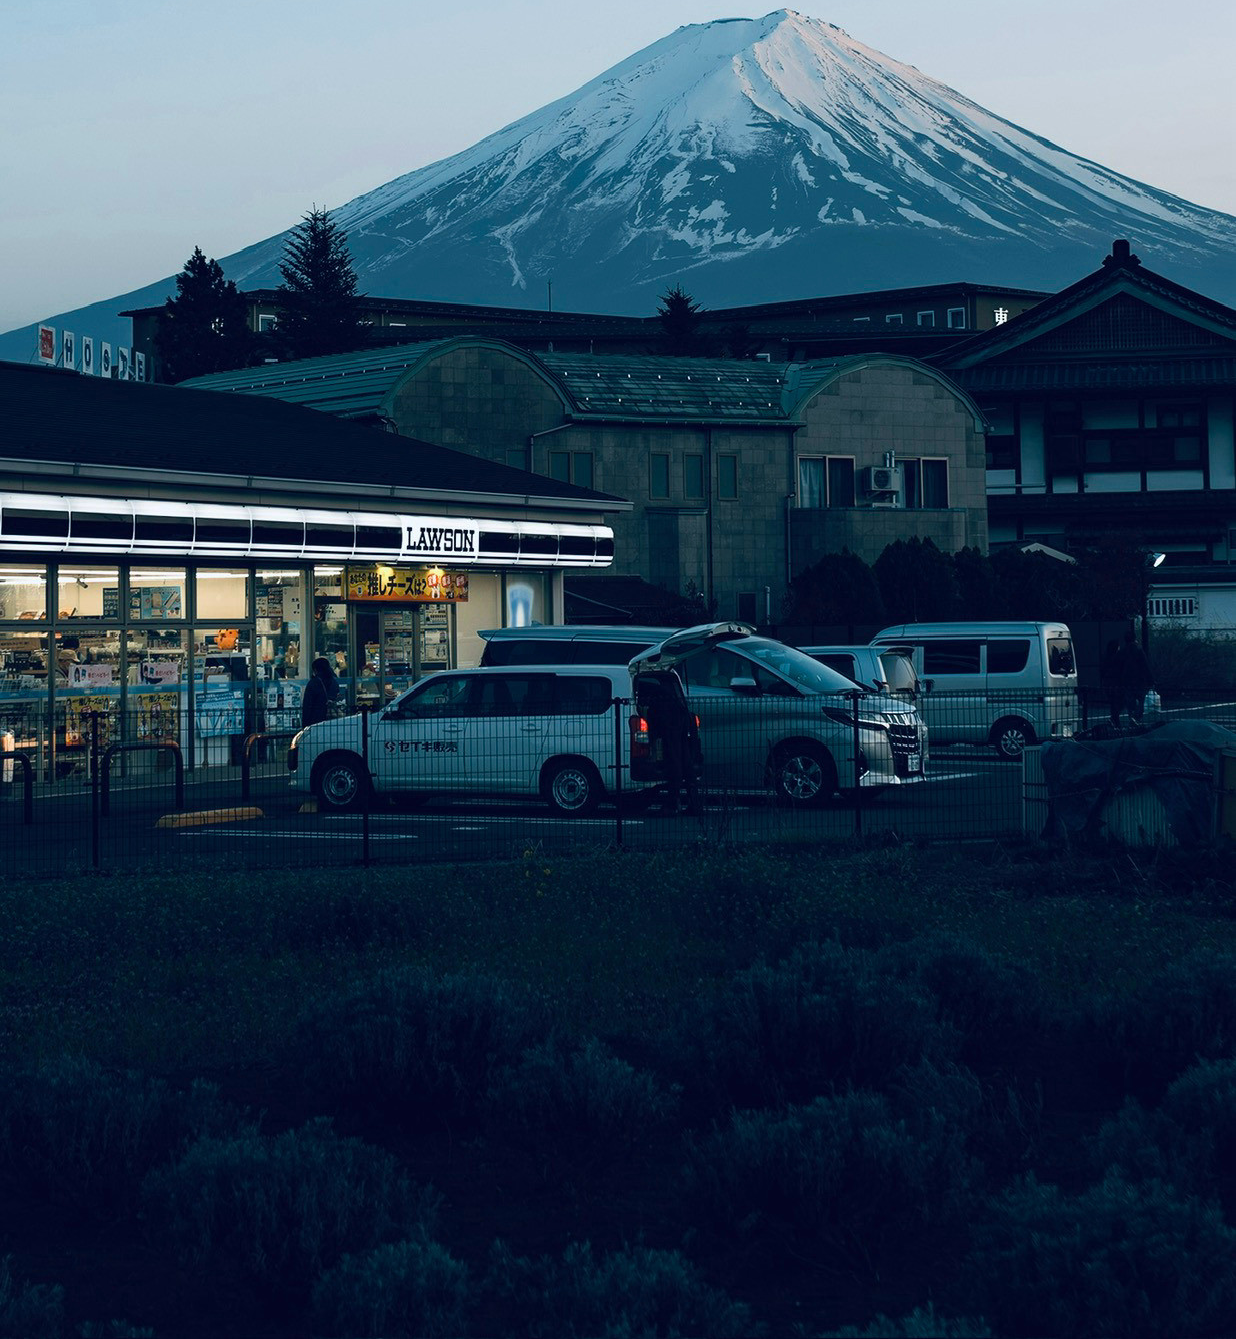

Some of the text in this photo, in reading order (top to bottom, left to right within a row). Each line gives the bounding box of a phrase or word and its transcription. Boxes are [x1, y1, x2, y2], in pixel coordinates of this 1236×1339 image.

[407, 527, 475, 552] LAWSON
[368, 572, 427, 596] 推しチーズは?
